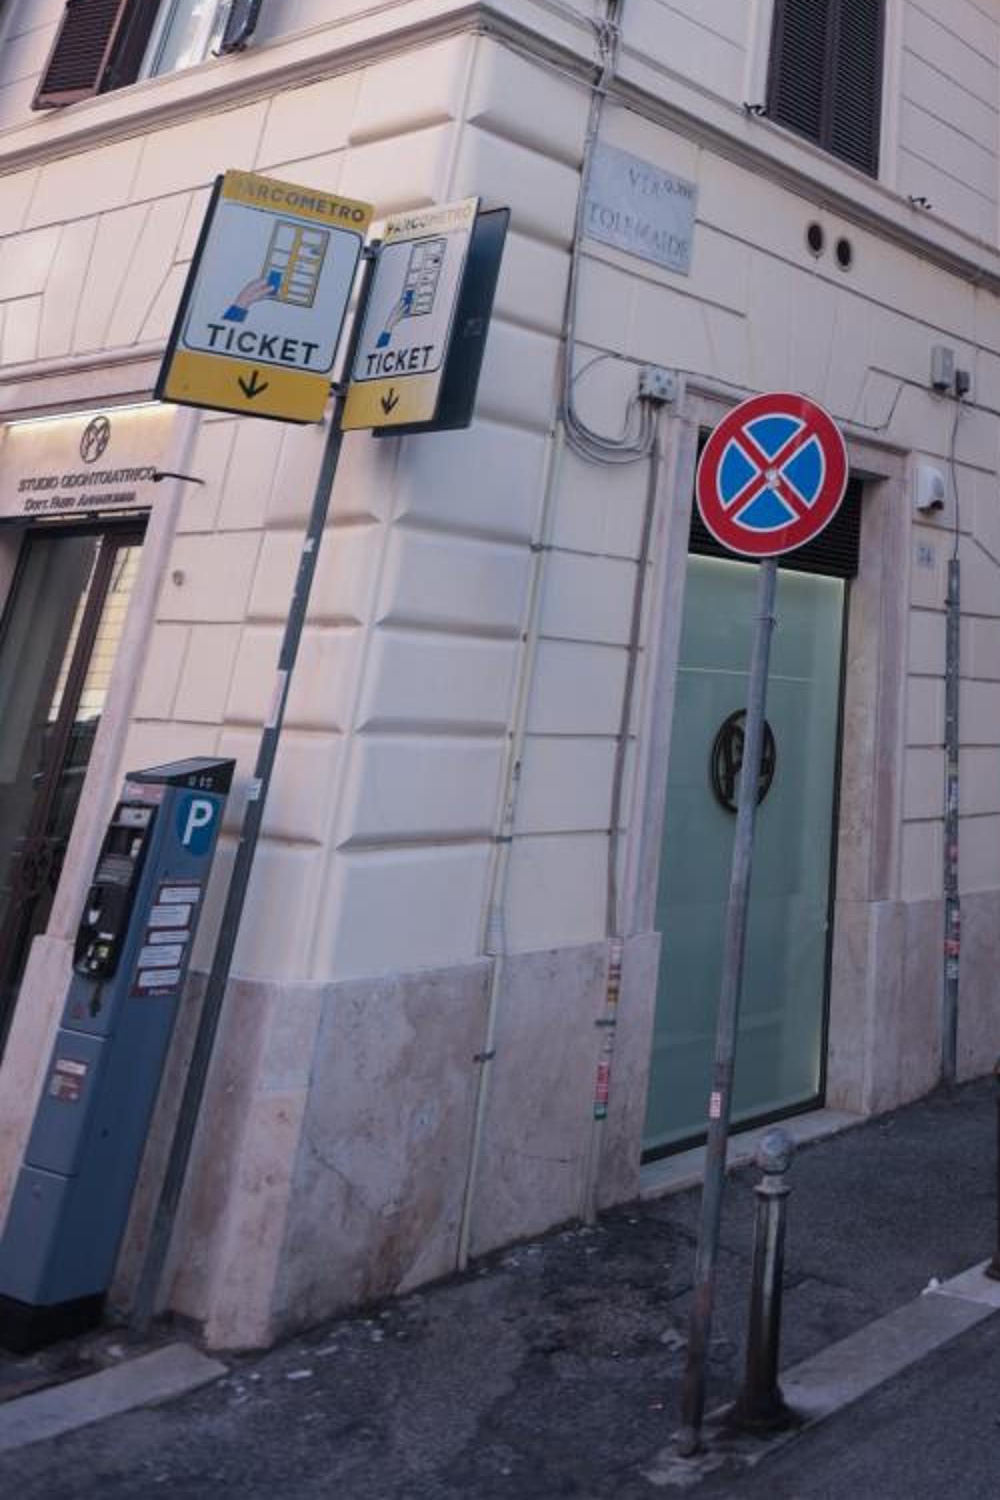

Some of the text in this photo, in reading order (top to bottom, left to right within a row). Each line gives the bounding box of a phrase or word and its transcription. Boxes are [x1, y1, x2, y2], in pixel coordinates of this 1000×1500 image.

[206, 323, 320, 366] TICKET
[365, 344, 434, 376] TICKET
[18, 476, 59, 492] STUDIO
[182, 799, 214, 845] P
